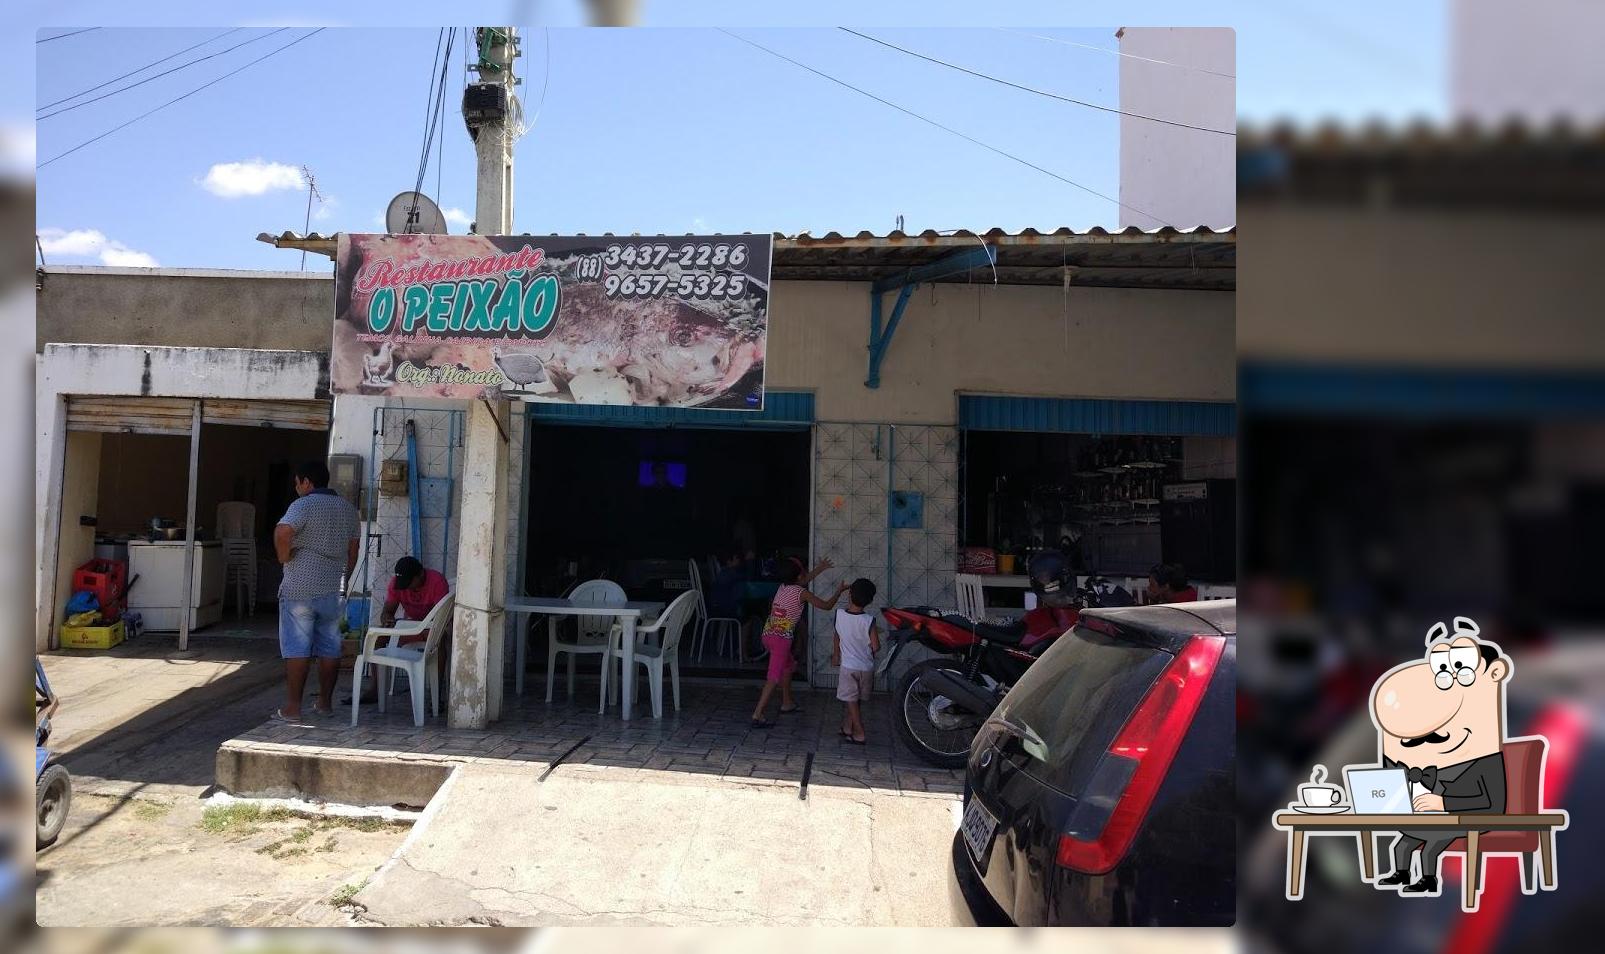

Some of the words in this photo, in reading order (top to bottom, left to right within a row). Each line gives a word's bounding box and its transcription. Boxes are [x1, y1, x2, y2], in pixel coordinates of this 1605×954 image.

[358, 245, 545, 290] Restaurante
[576, 256, 602, 281] (88)
[605, 245, 746, 268] 3437-2286
[368, 287, 396, 333] O
[402, 270, 559, 333] PEIXÃO
[604, 275, 745, 297] 9657-5325
[440, 363, 502, 386] Nonato
